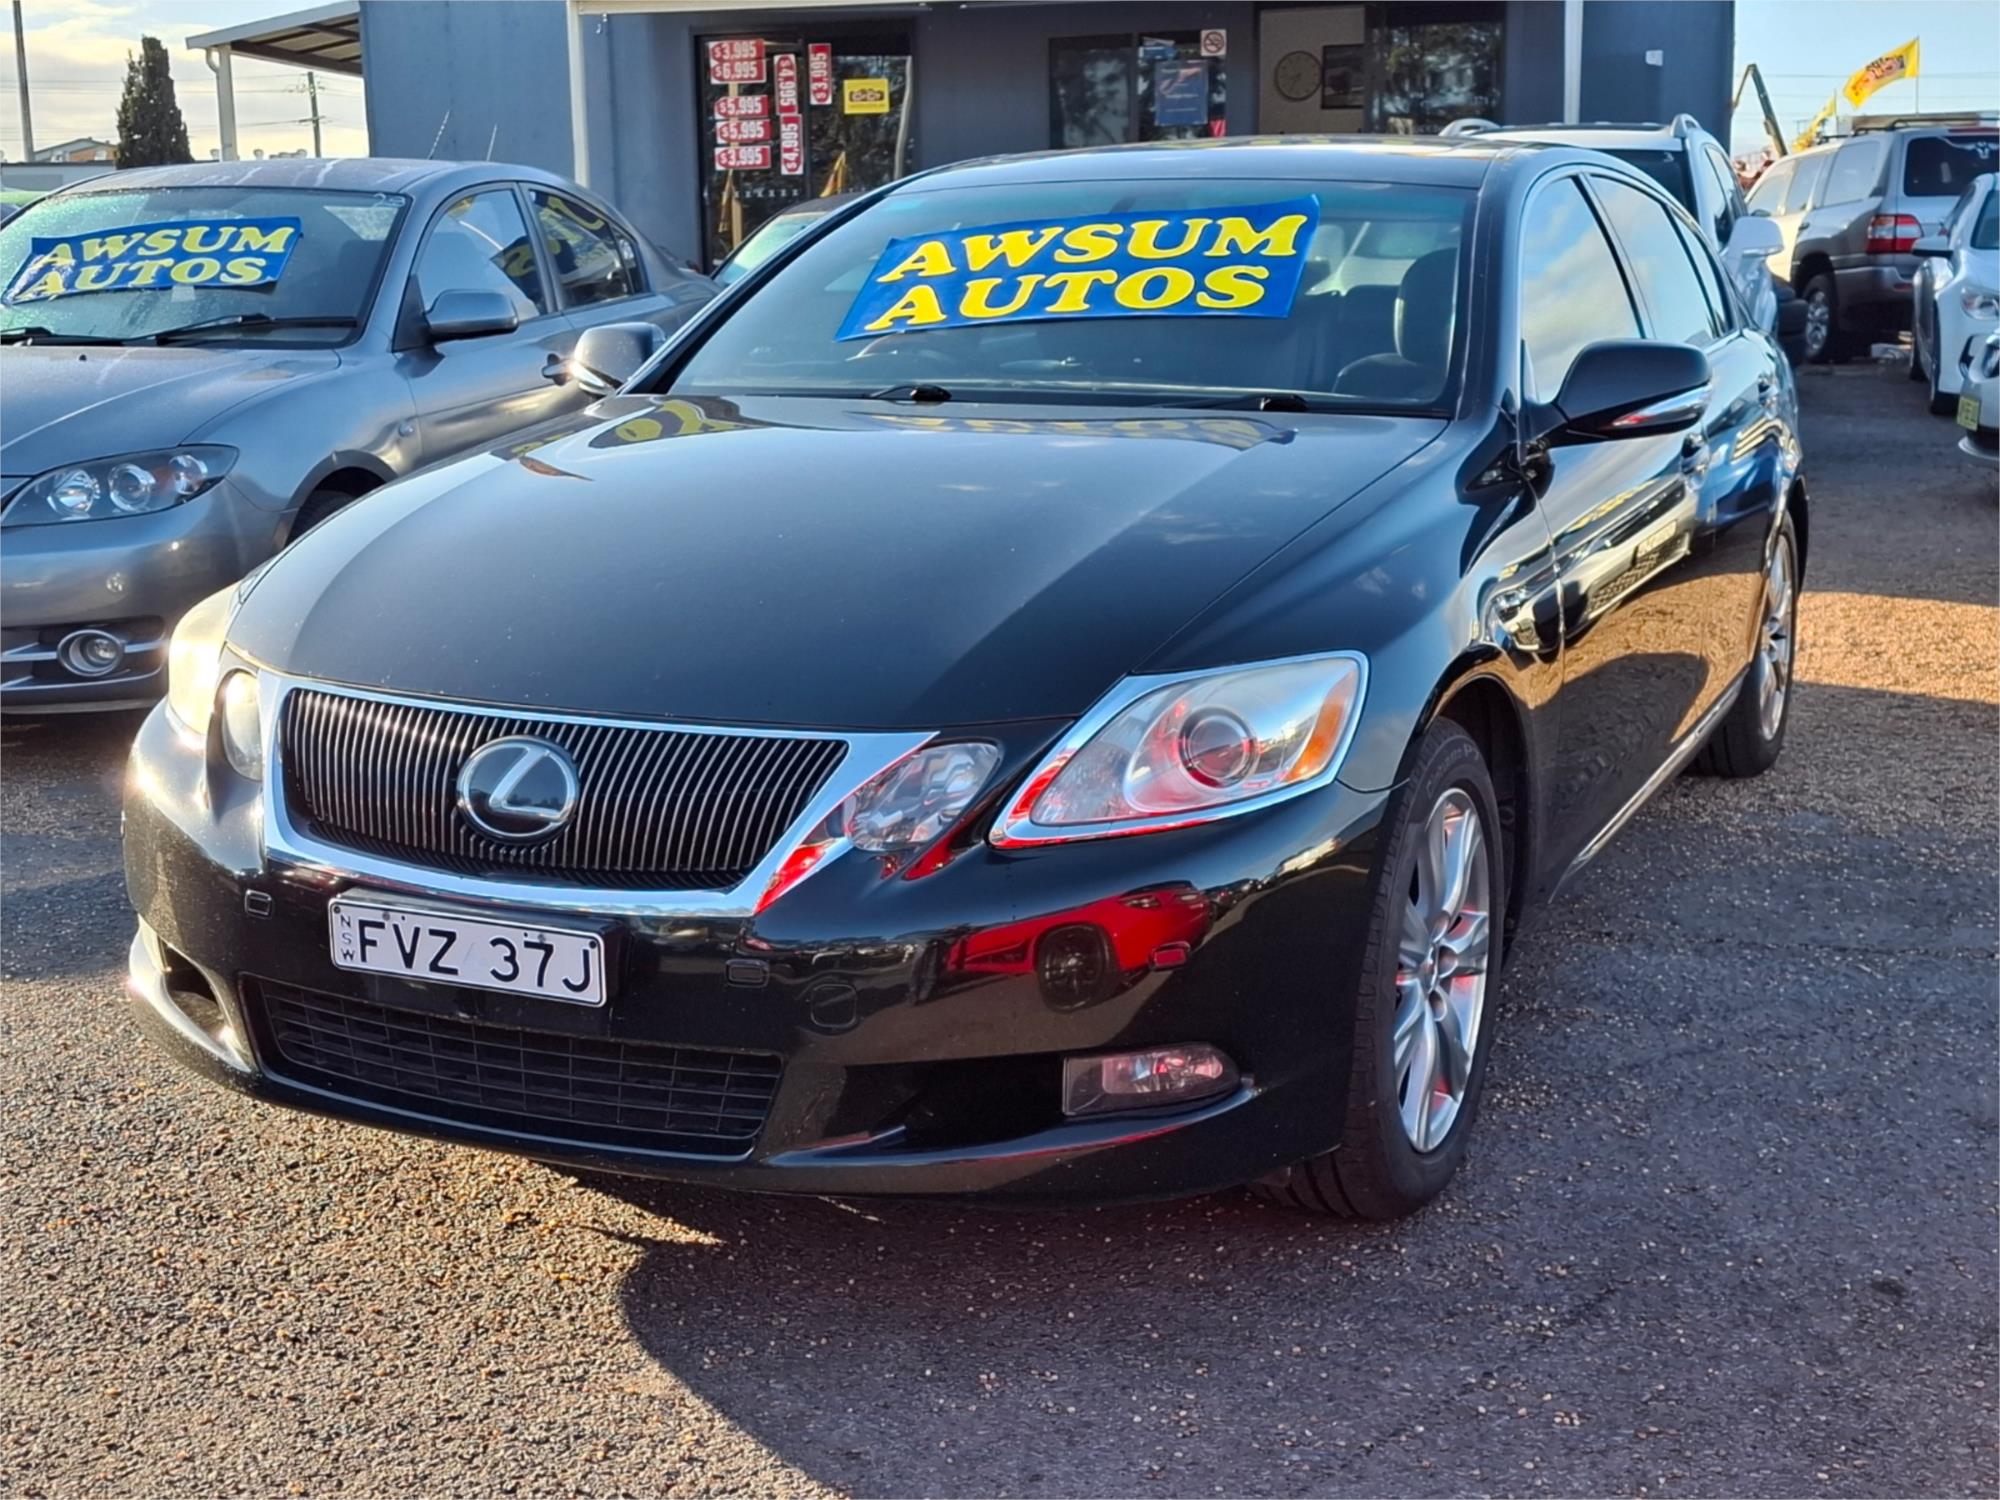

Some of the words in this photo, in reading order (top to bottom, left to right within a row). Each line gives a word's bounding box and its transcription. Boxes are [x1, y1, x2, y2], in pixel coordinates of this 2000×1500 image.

[781, 122, 800, 170] $4,995
[26, 226, 295, 271] AWSUM
[876, 213, 1308, 283] AWSUM
[12, 257, 267, 303] AUTOS
[864, 264, 1269, 331] AUTOS
[340, 914, 356, 961] NSW
[357, 919, 459, 976] FVZ
[489, 937, 591, 993] 37J
